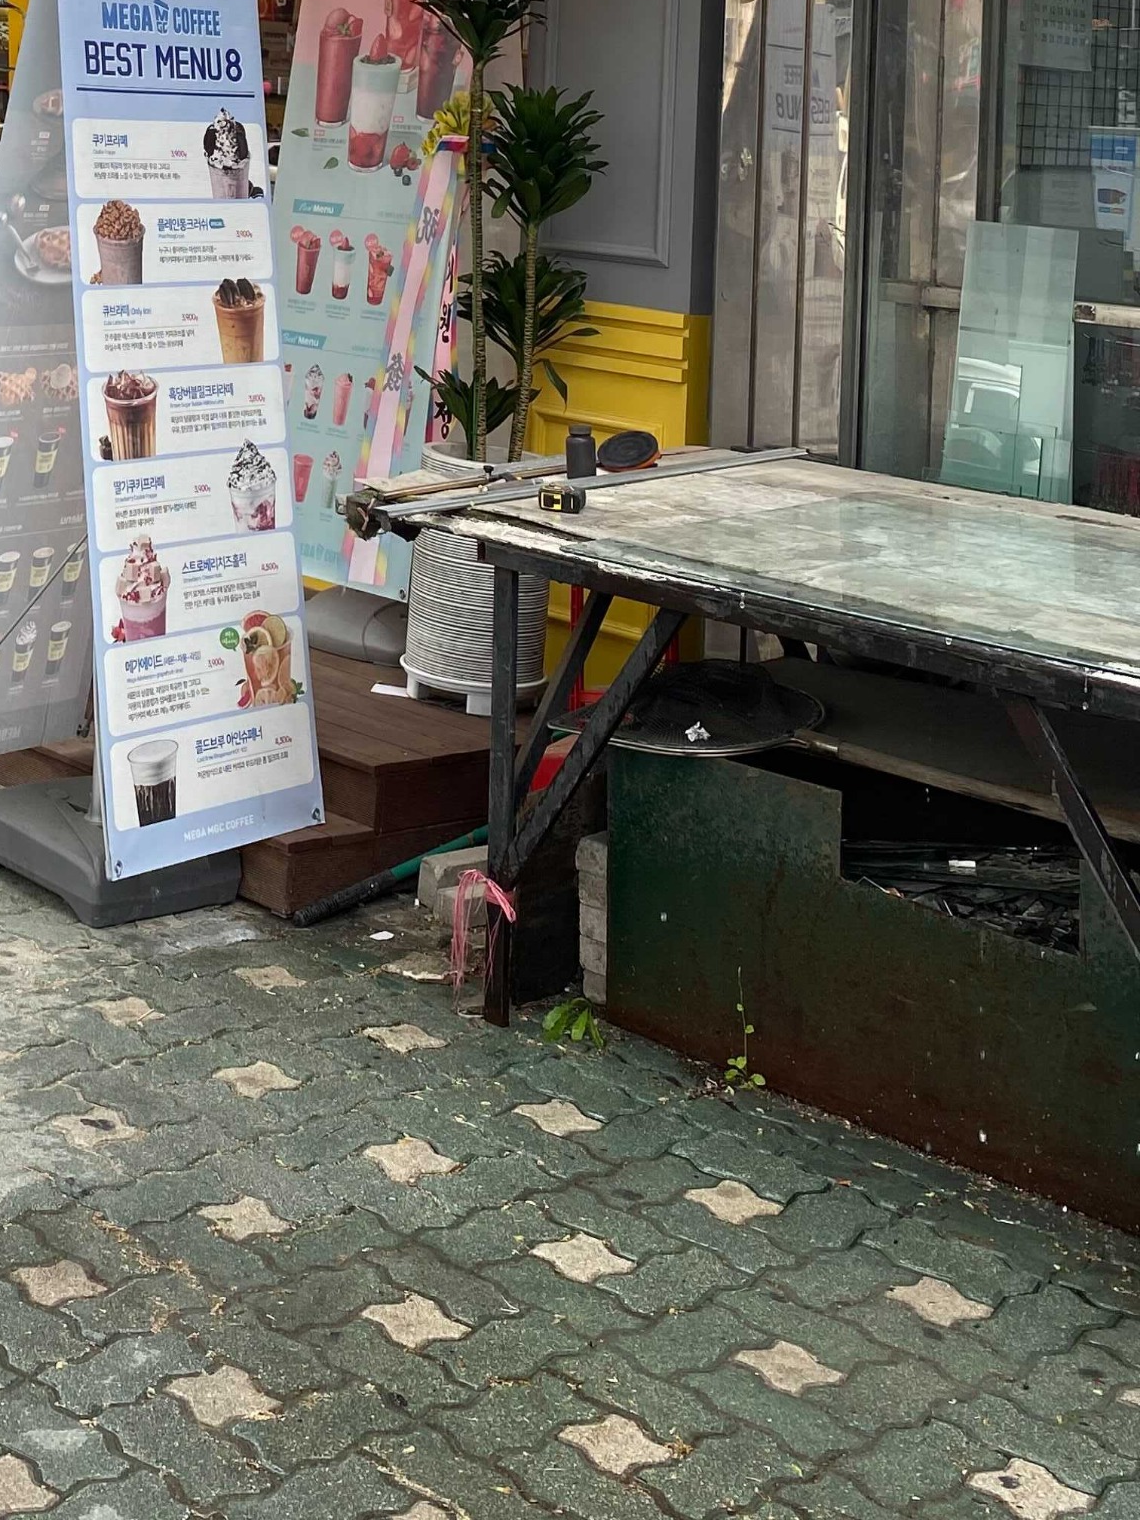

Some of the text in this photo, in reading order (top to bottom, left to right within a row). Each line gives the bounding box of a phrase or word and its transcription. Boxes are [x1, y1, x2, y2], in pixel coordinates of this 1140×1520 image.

[101, 1, 153, 32] MEGA
[172, 9, 221, 36] COFFEE
[84, 40, 147, 78] BEST
[313, 204, 334, 214] Menu
[298, 335, 319, 347] Menu
[183, 814, 255, 842] MEGA MGC COFFEE
